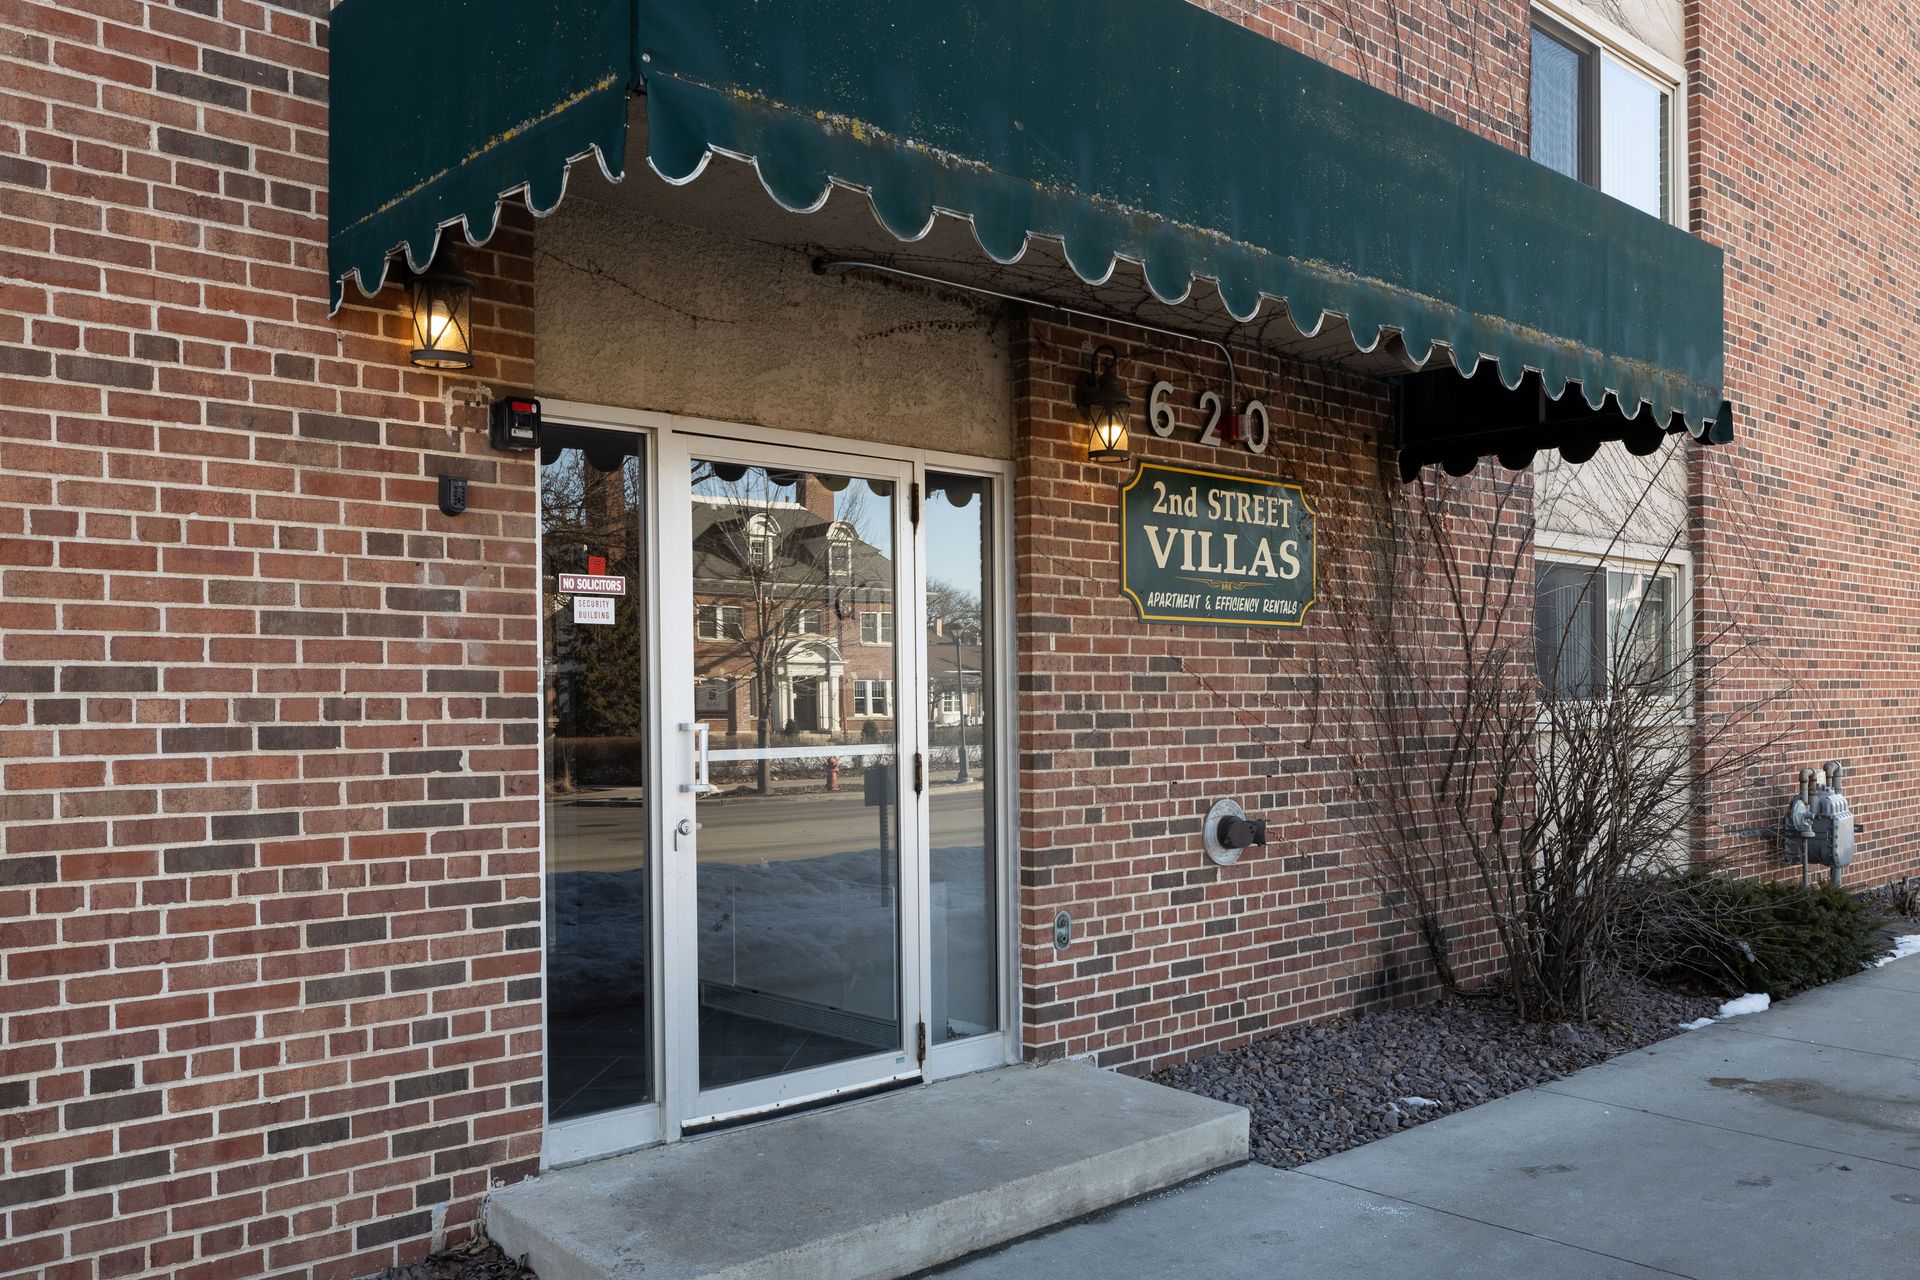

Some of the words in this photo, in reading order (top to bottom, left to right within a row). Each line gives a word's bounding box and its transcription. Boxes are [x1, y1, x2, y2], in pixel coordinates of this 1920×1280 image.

[1150, 380, 1269, 453] 620
[1152, 480, 1198, 518] 2nd
[1208, 488, 1293, 528] STREET
[1143, 524, 1300, 580] VILLAS
[563, 577, 575, 589] NO
[576, 578, 622, 591] SOLICITORS
[578, 599, 609, 608] SECURITY
[578, 611, 610, 619] BUILDING
[1147, 591, 1200, 609] APARTMENT
[1205, 596, 1211, 610] &
[1215, 595, 1260, 613] EFFICIENCY
[1263, 598, 1297, 615] RENTALS
